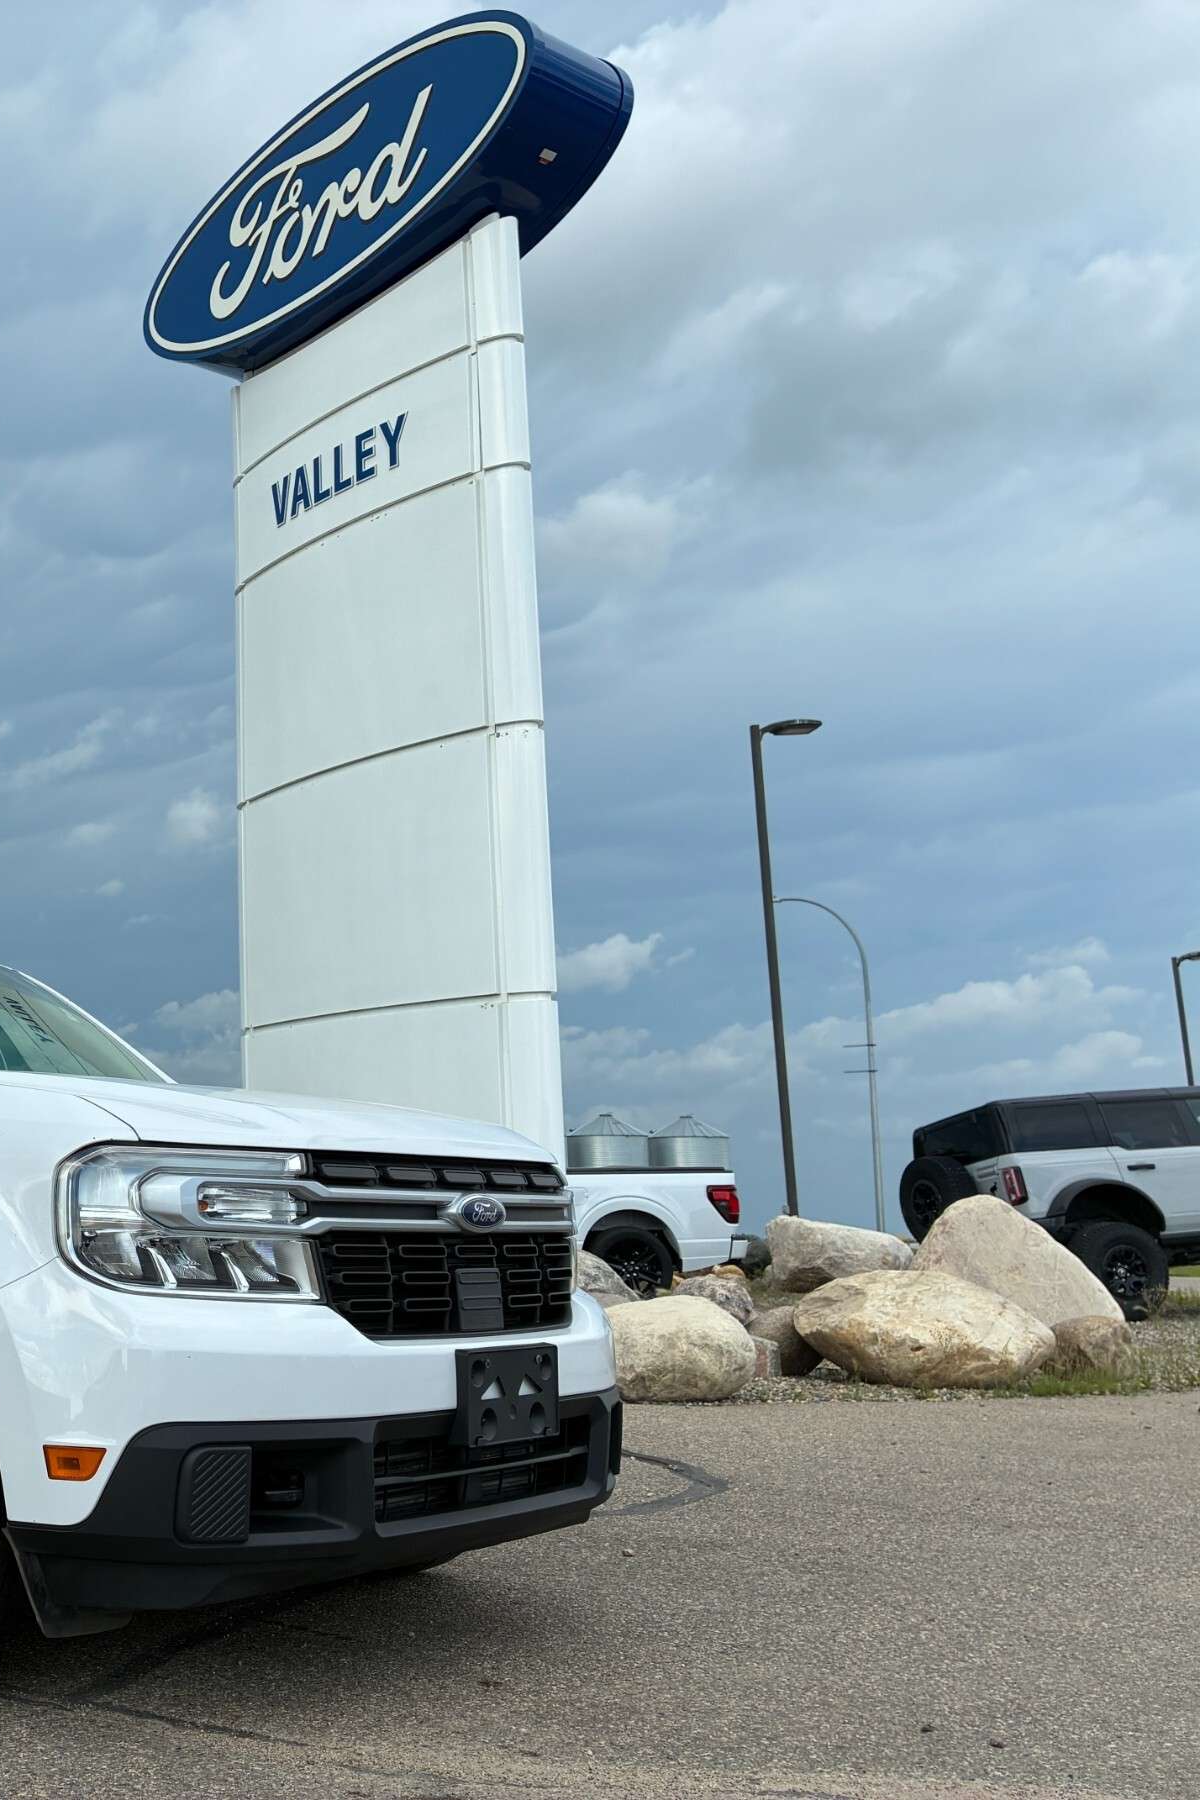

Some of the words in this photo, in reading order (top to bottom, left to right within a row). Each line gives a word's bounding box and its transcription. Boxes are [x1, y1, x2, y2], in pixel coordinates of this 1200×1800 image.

[209, 83, 433, 320] Ford
[271, 412, 408, 527] VALLEY
[472, 1201, 498, 1222] Ford
